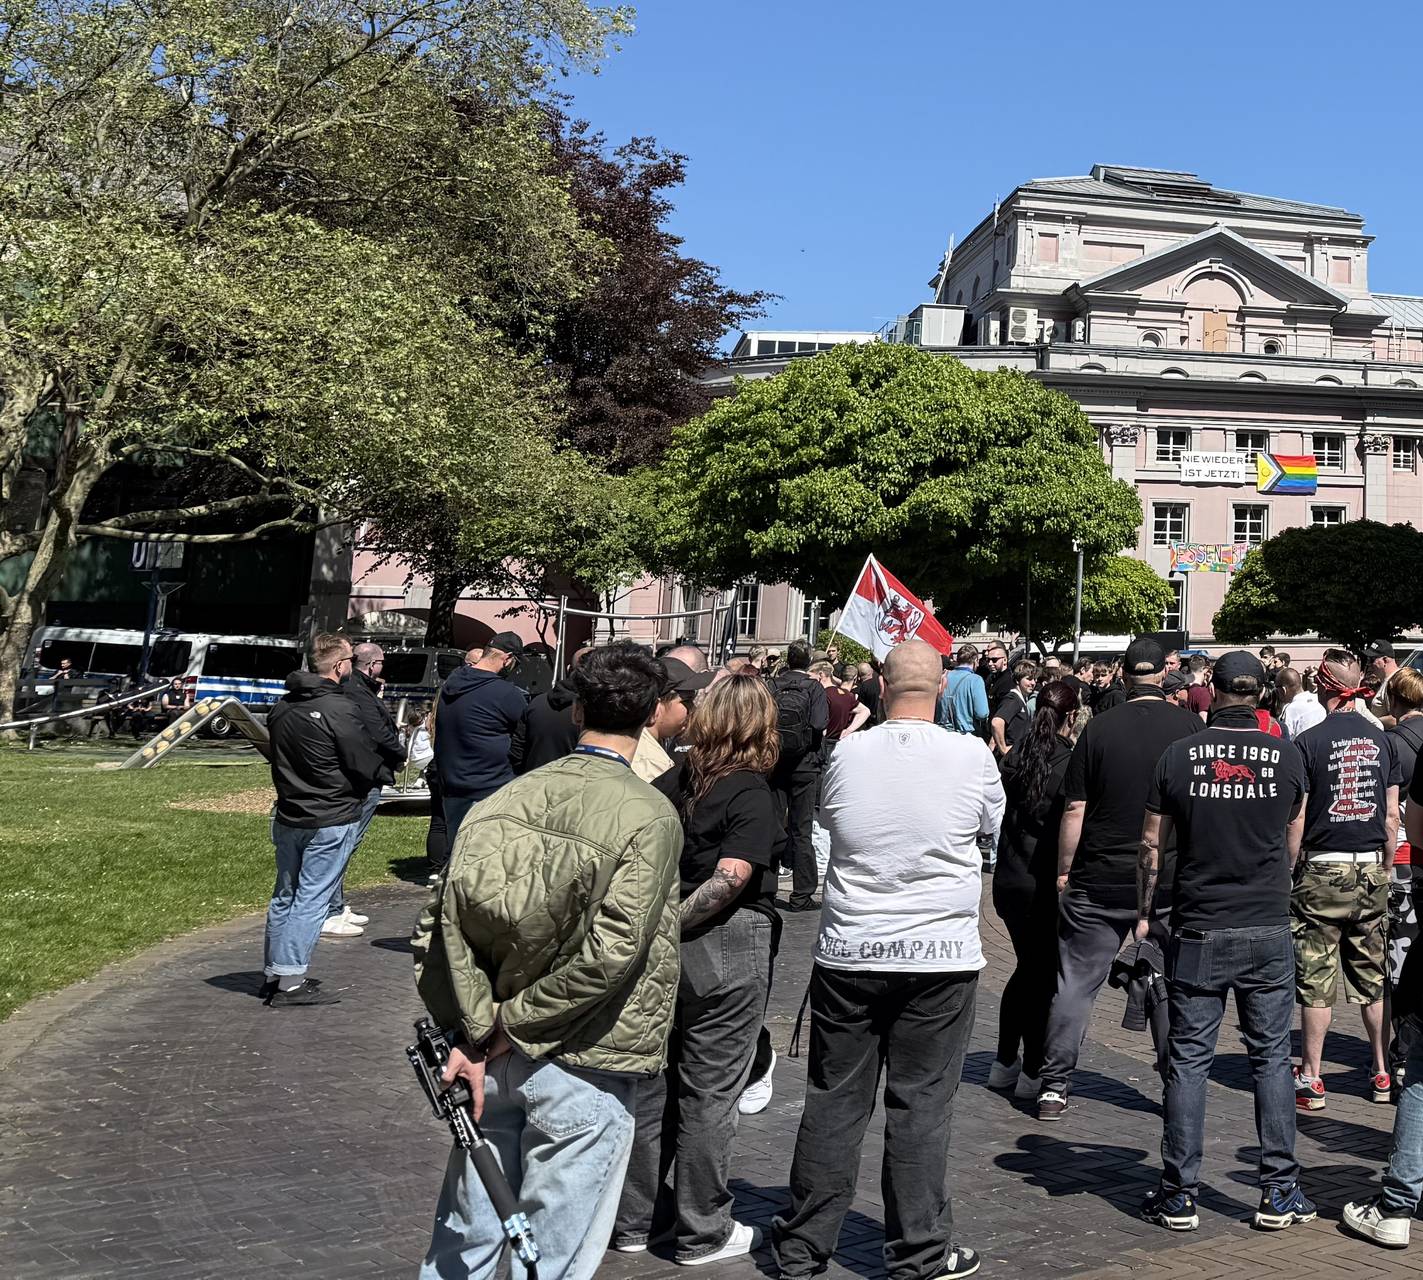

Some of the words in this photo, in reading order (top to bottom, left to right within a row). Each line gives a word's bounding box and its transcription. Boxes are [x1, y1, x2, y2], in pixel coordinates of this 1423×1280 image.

[1182, 455, 1200, 463] NIE
[1201, 455, 1244, 465] WIEDER
[1184, 469, 1202, 477] IST
[1204, 470, 1240, 479] JETZT!
[1176, 543, 1223, 565] ESSEN
[1189, 744, 1236, 761] SINCE
[1242, 745, 1281, 764] 1960
[1193, 765, 1207, 775] UK
[1261, 767, 1274, 778] GB
[1189, 782, 1278, 799] LONSDALE
[858, 940, 964, 960] COMPANY
